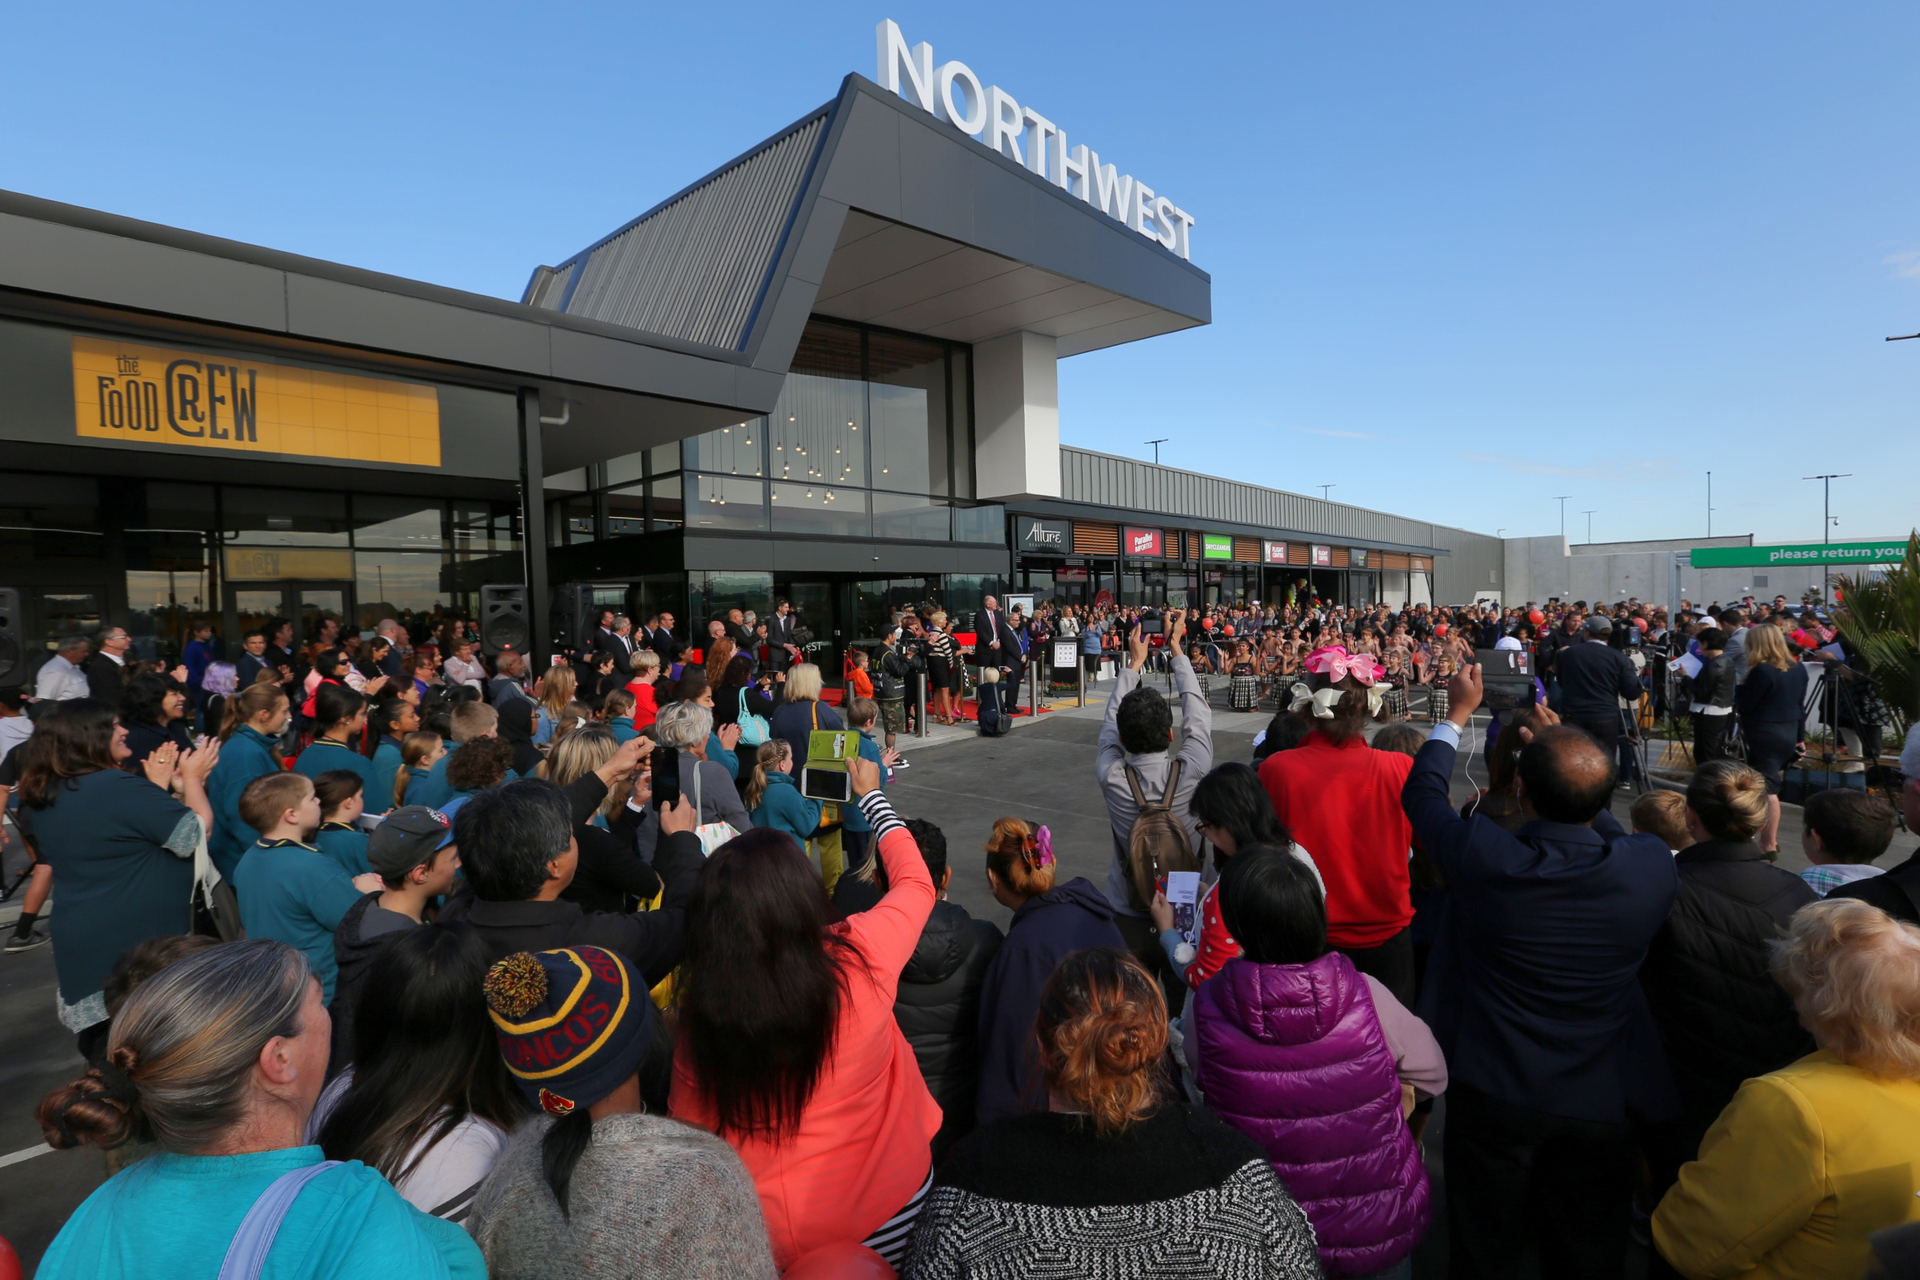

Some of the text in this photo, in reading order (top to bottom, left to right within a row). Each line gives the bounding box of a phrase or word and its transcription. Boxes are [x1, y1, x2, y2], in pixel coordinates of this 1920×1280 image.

[876, 18, 1194, 261] NORTHWEST
[116, 355, 141, 376] the
[165, 359, 257, 442] CREW
[1134, 532, 1153, 545] Parallel
[1135, 542, 1153, 553] IMPORTED
[1205, 543, 1231, 551] DRYCLEANERS
[1770, 549, 1818, 561] please
[1822, 548, 1871, 558] return
[580, 947, 620, 986] BR
[502, 994, 610, 1068] ONCOS
